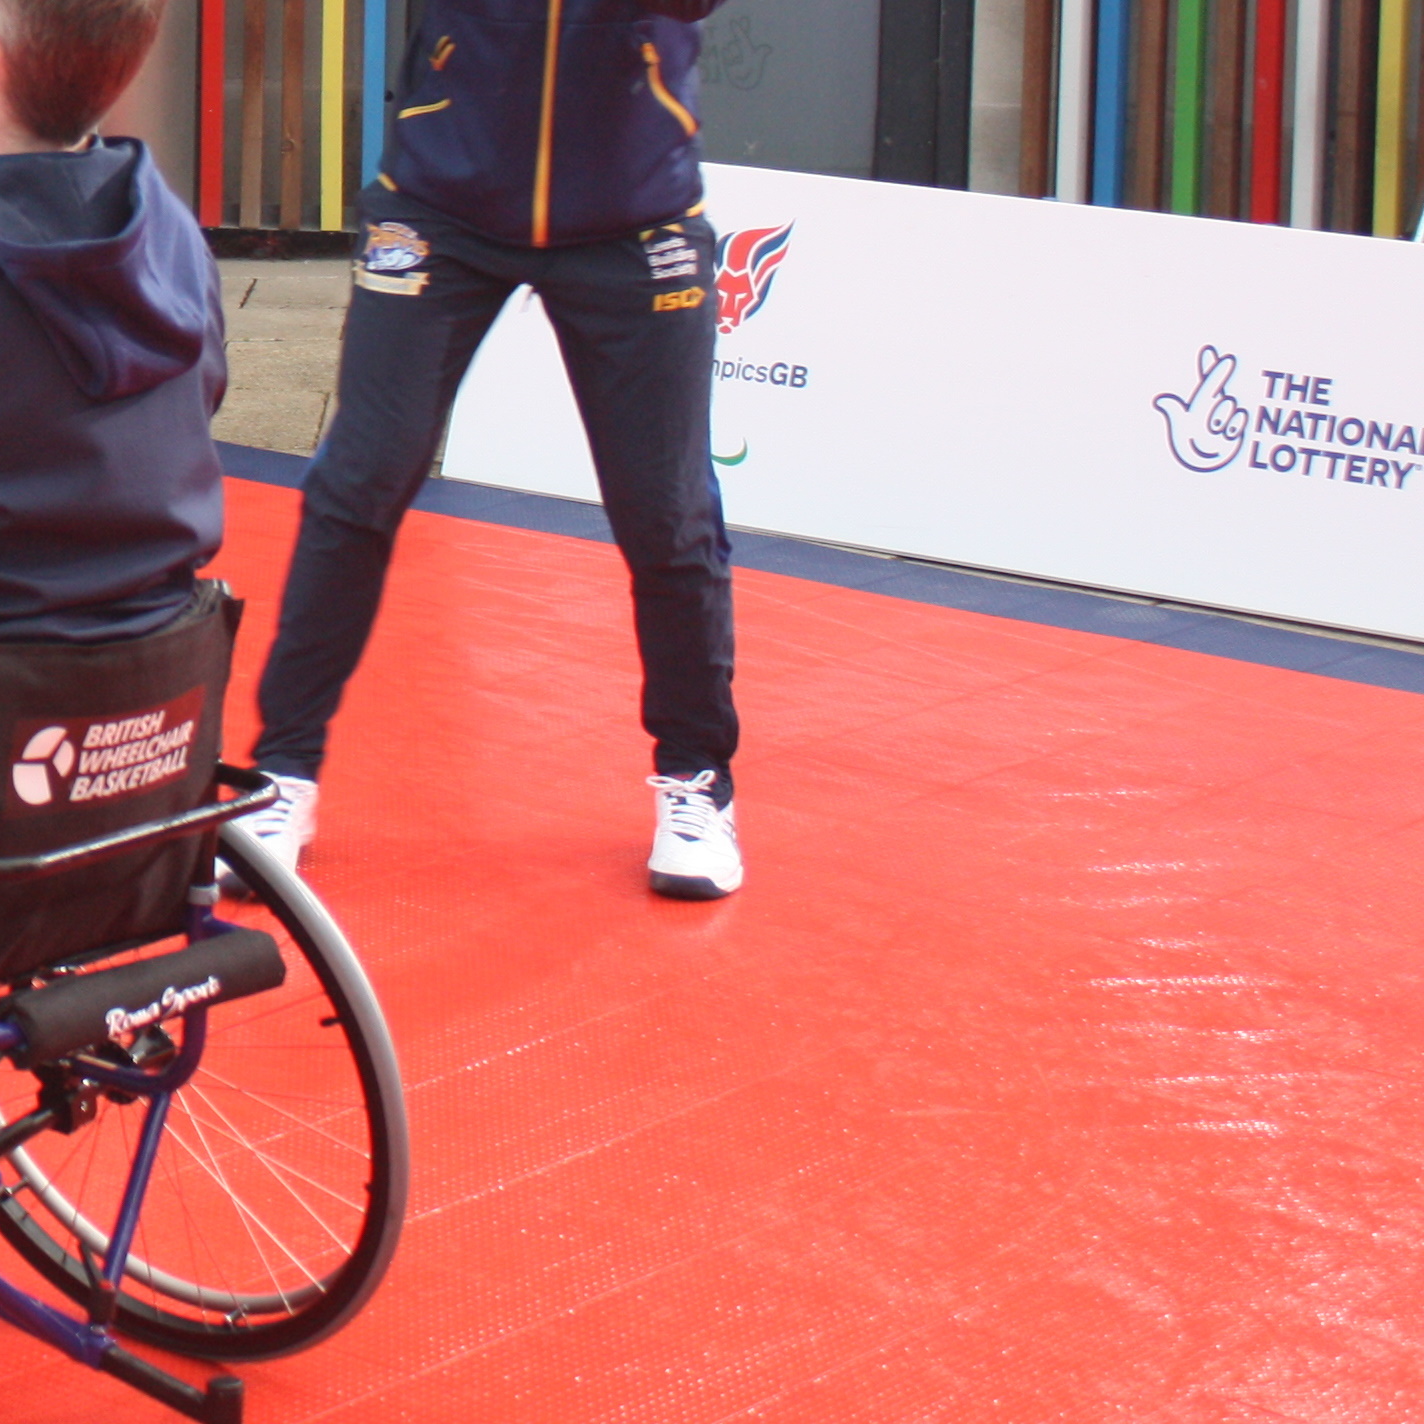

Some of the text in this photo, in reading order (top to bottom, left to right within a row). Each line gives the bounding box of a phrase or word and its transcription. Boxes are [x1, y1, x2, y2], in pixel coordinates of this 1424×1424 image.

[1261, 369, 1333, 406] THE
[1248, 440, 1415, 490] LOTTERY
[78, 720, 194, 774] WHEELCHAIR
[82, 709, 166, 749] BRITISH
[69, 745, 187, 801] BASKETBALL
